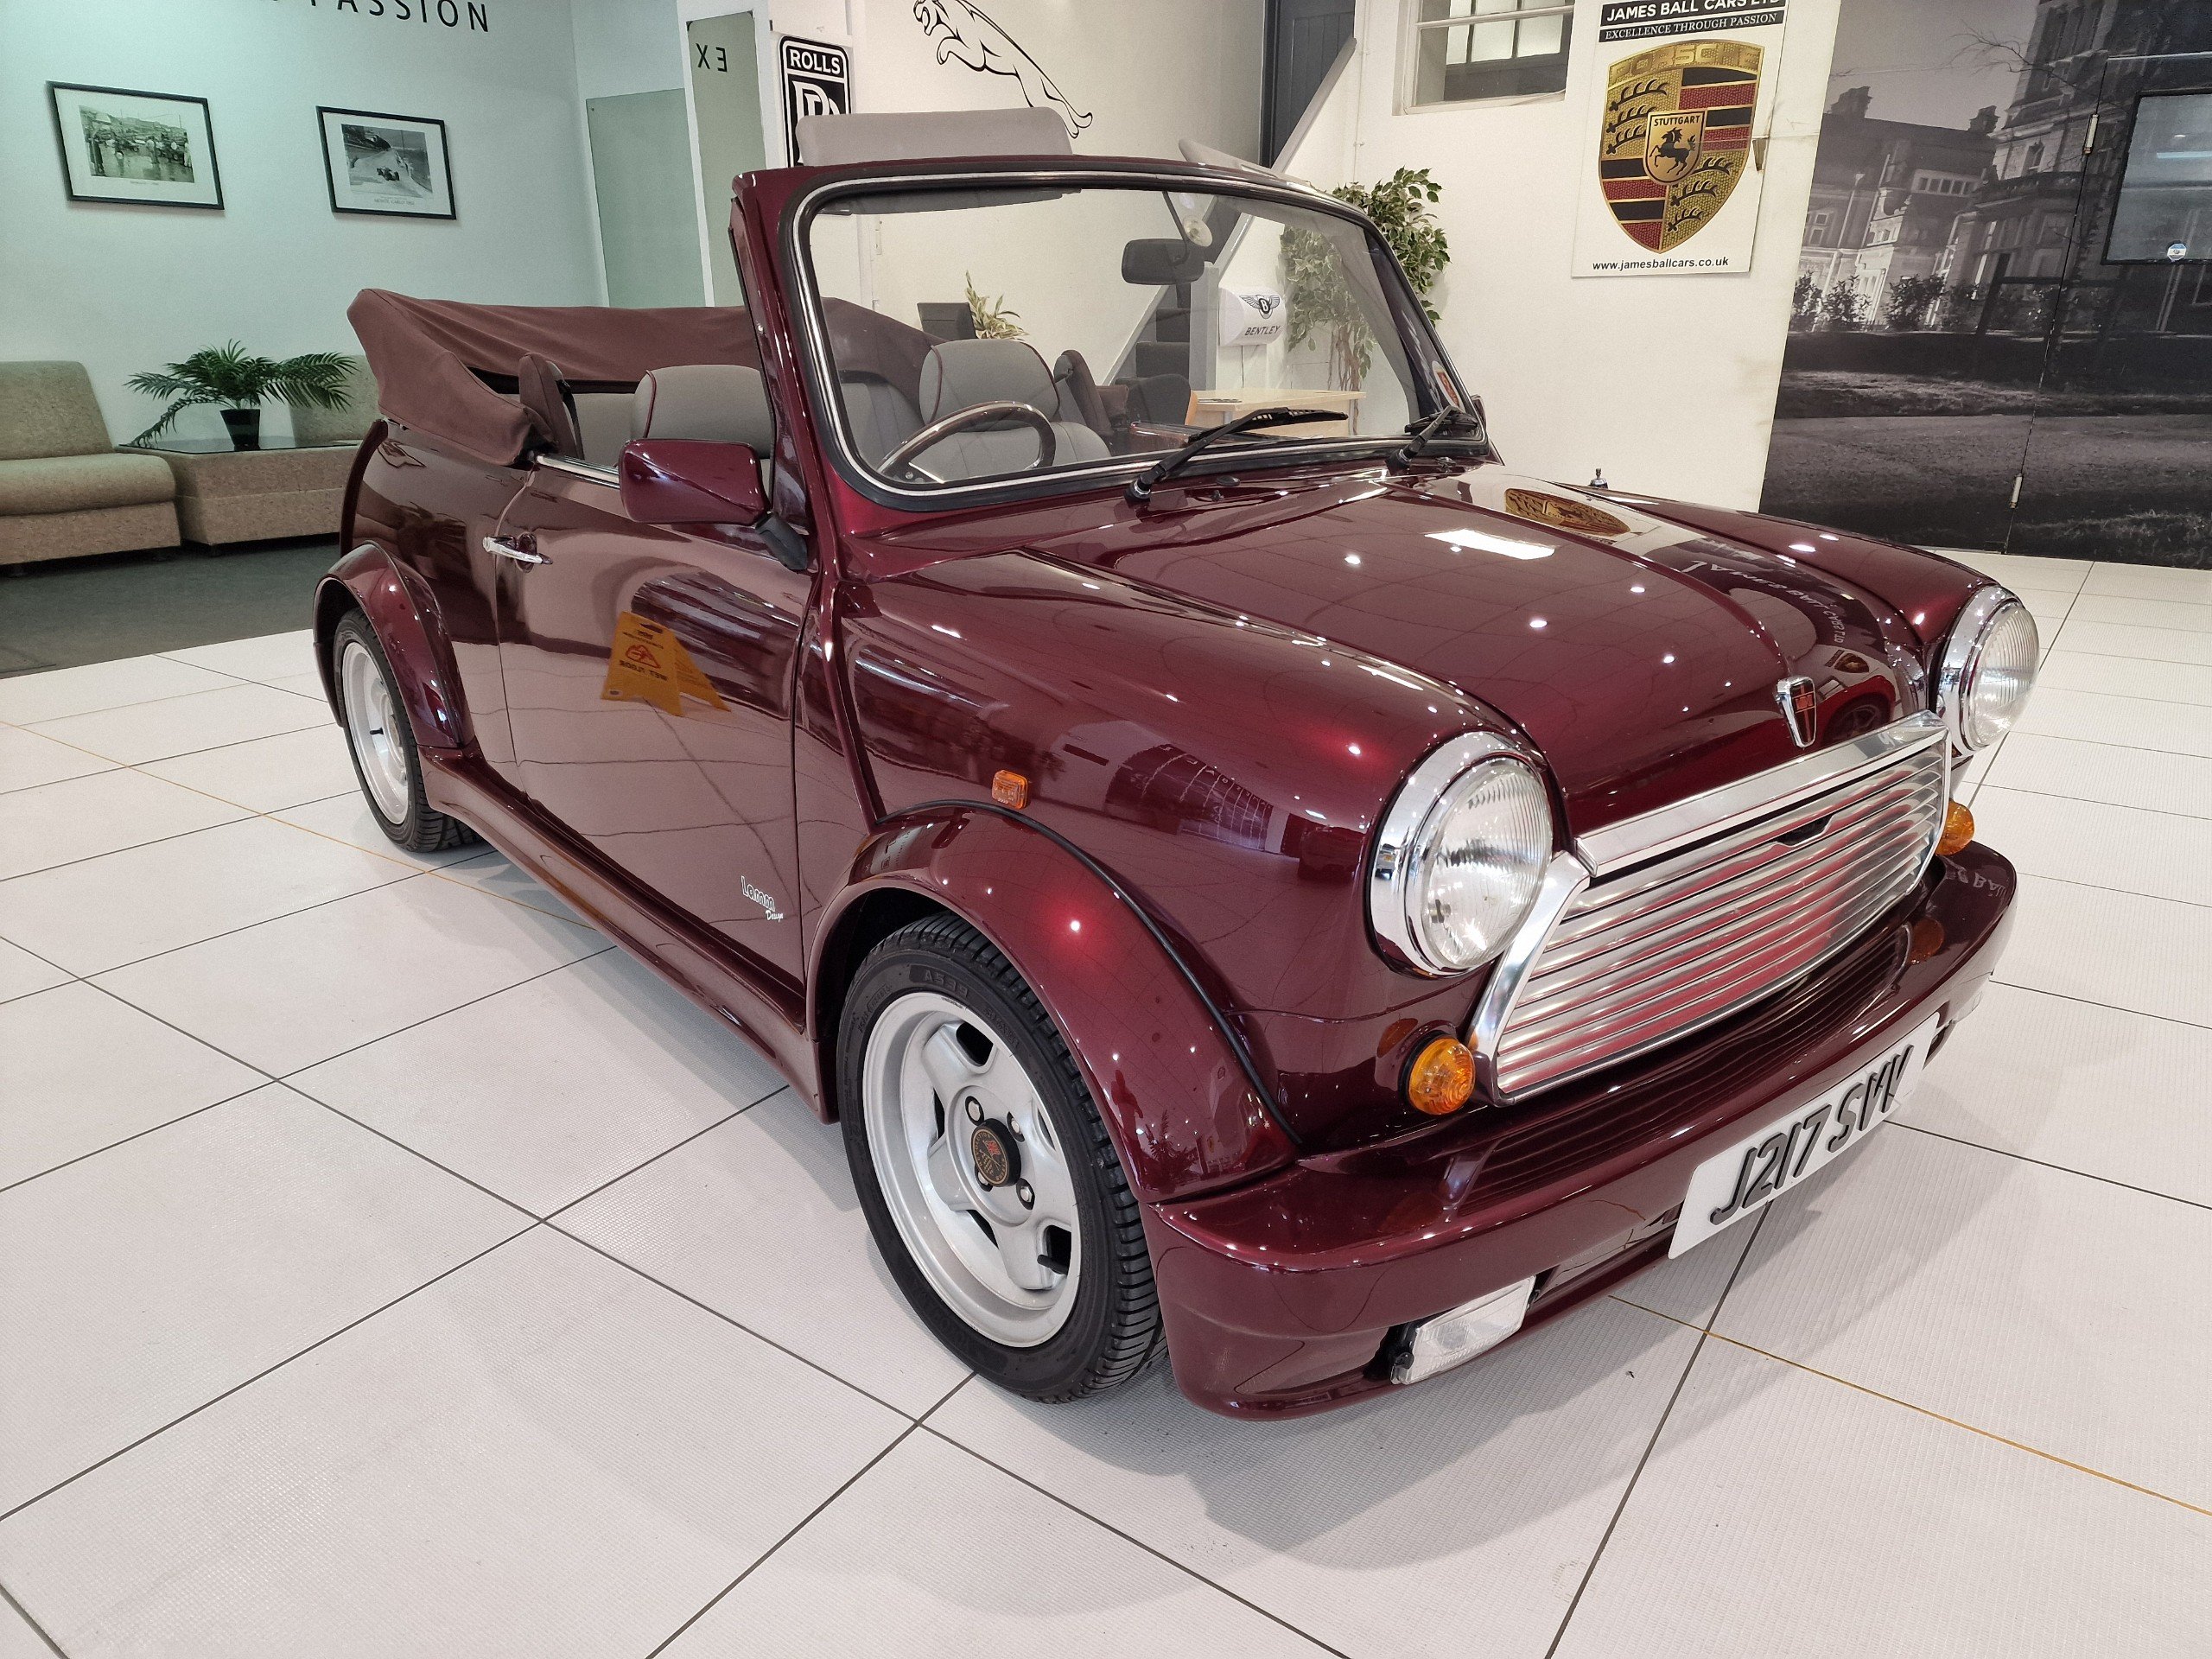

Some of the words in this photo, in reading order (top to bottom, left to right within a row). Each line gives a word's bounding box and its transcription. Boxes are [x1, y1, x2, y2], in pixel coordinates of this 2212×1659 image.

[310, 0, 488, 32] SSION
[1606, 3, 1656, 22] JAMES
[1660, 0, 1699, 16] BALL
[1605, 24, 1671, 40] EXCELLENCE
[1673, 18, 1727, 33] THROUGH
[1730, 13, 1777, 27] PASSION
[789, 48, 841, 74] ROLLS
[1609, 44, 1760, 82] PORSCHE
[1653, 115, 1700, 127] STUTTGART
[1592, 257, 1729, 271] www.jamesballcars.co.uk
[1244, 325, 1281, 336] BENTLEY
[1709, 1104, 1832, 1225] J217
